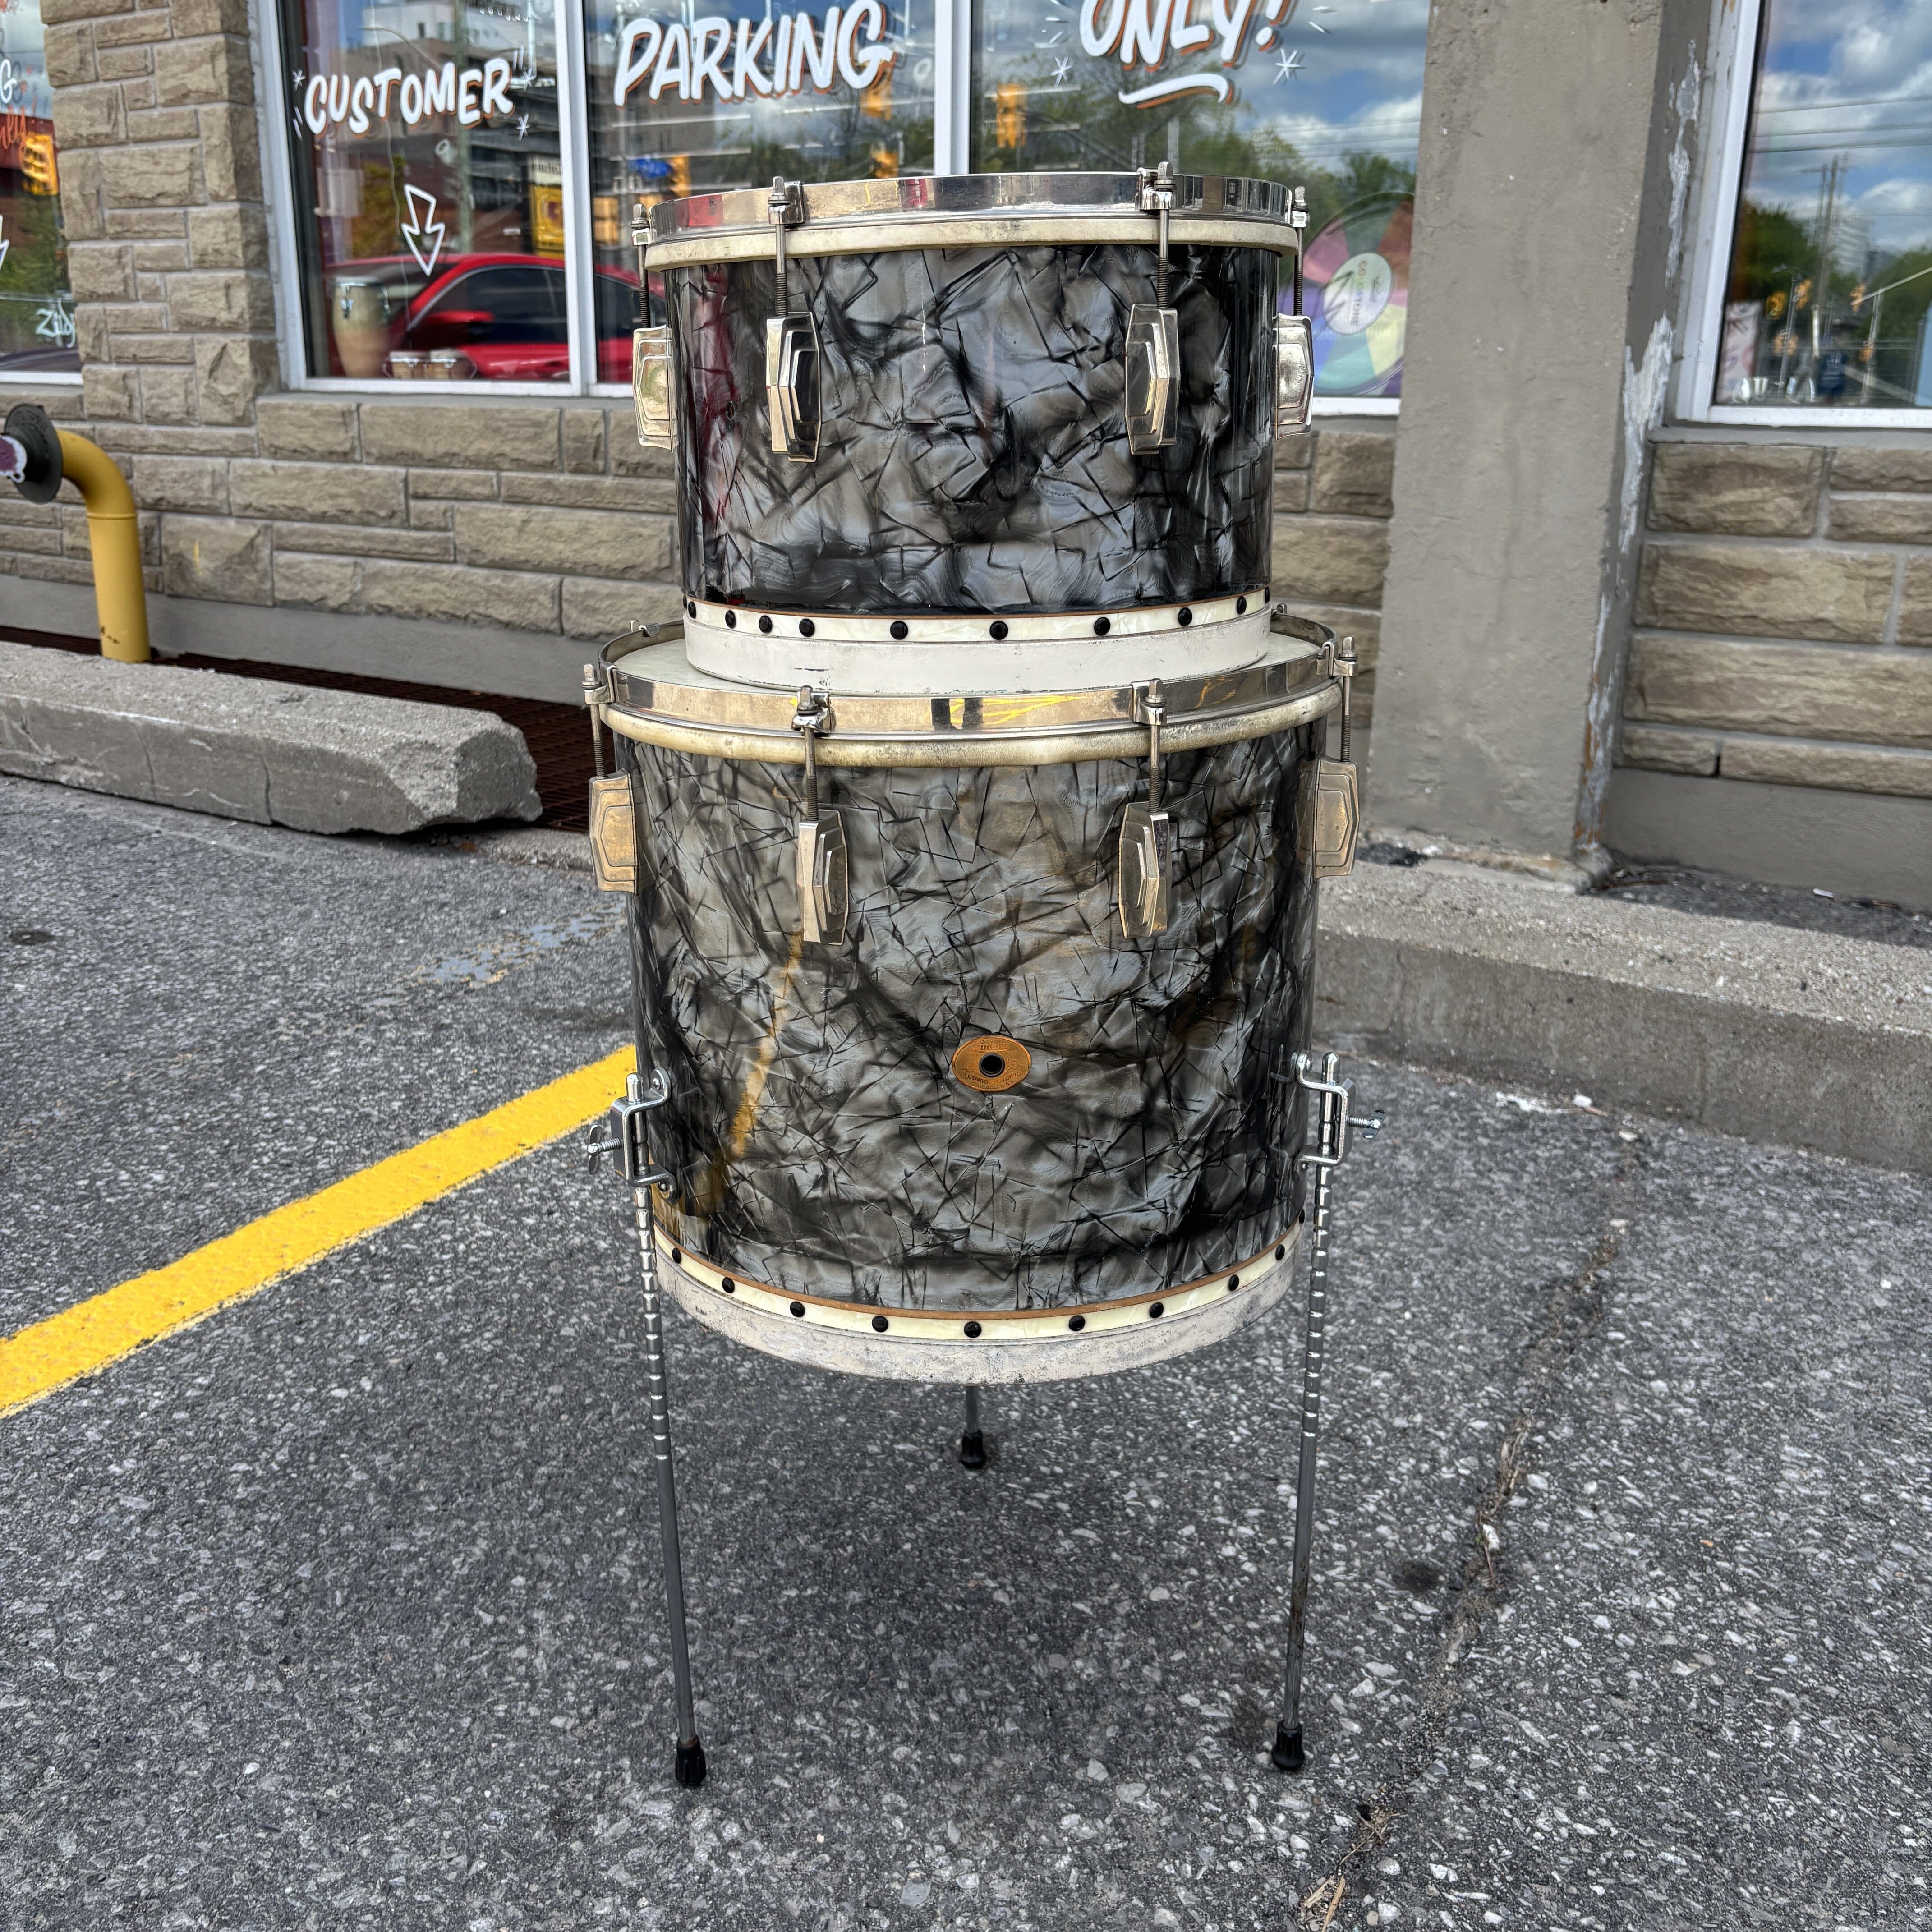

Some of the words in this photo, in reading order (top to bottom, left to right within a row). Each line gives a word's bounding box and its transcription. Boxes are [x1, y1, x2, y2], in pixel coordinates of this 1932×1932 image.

[304, 58, 514, 135] CUSTOMER
[613, 0, 895, 106] PARKING
[1079, 0, 1285, 65] ONLY!
[965, 1072, 988, 1084] LUDWIG
